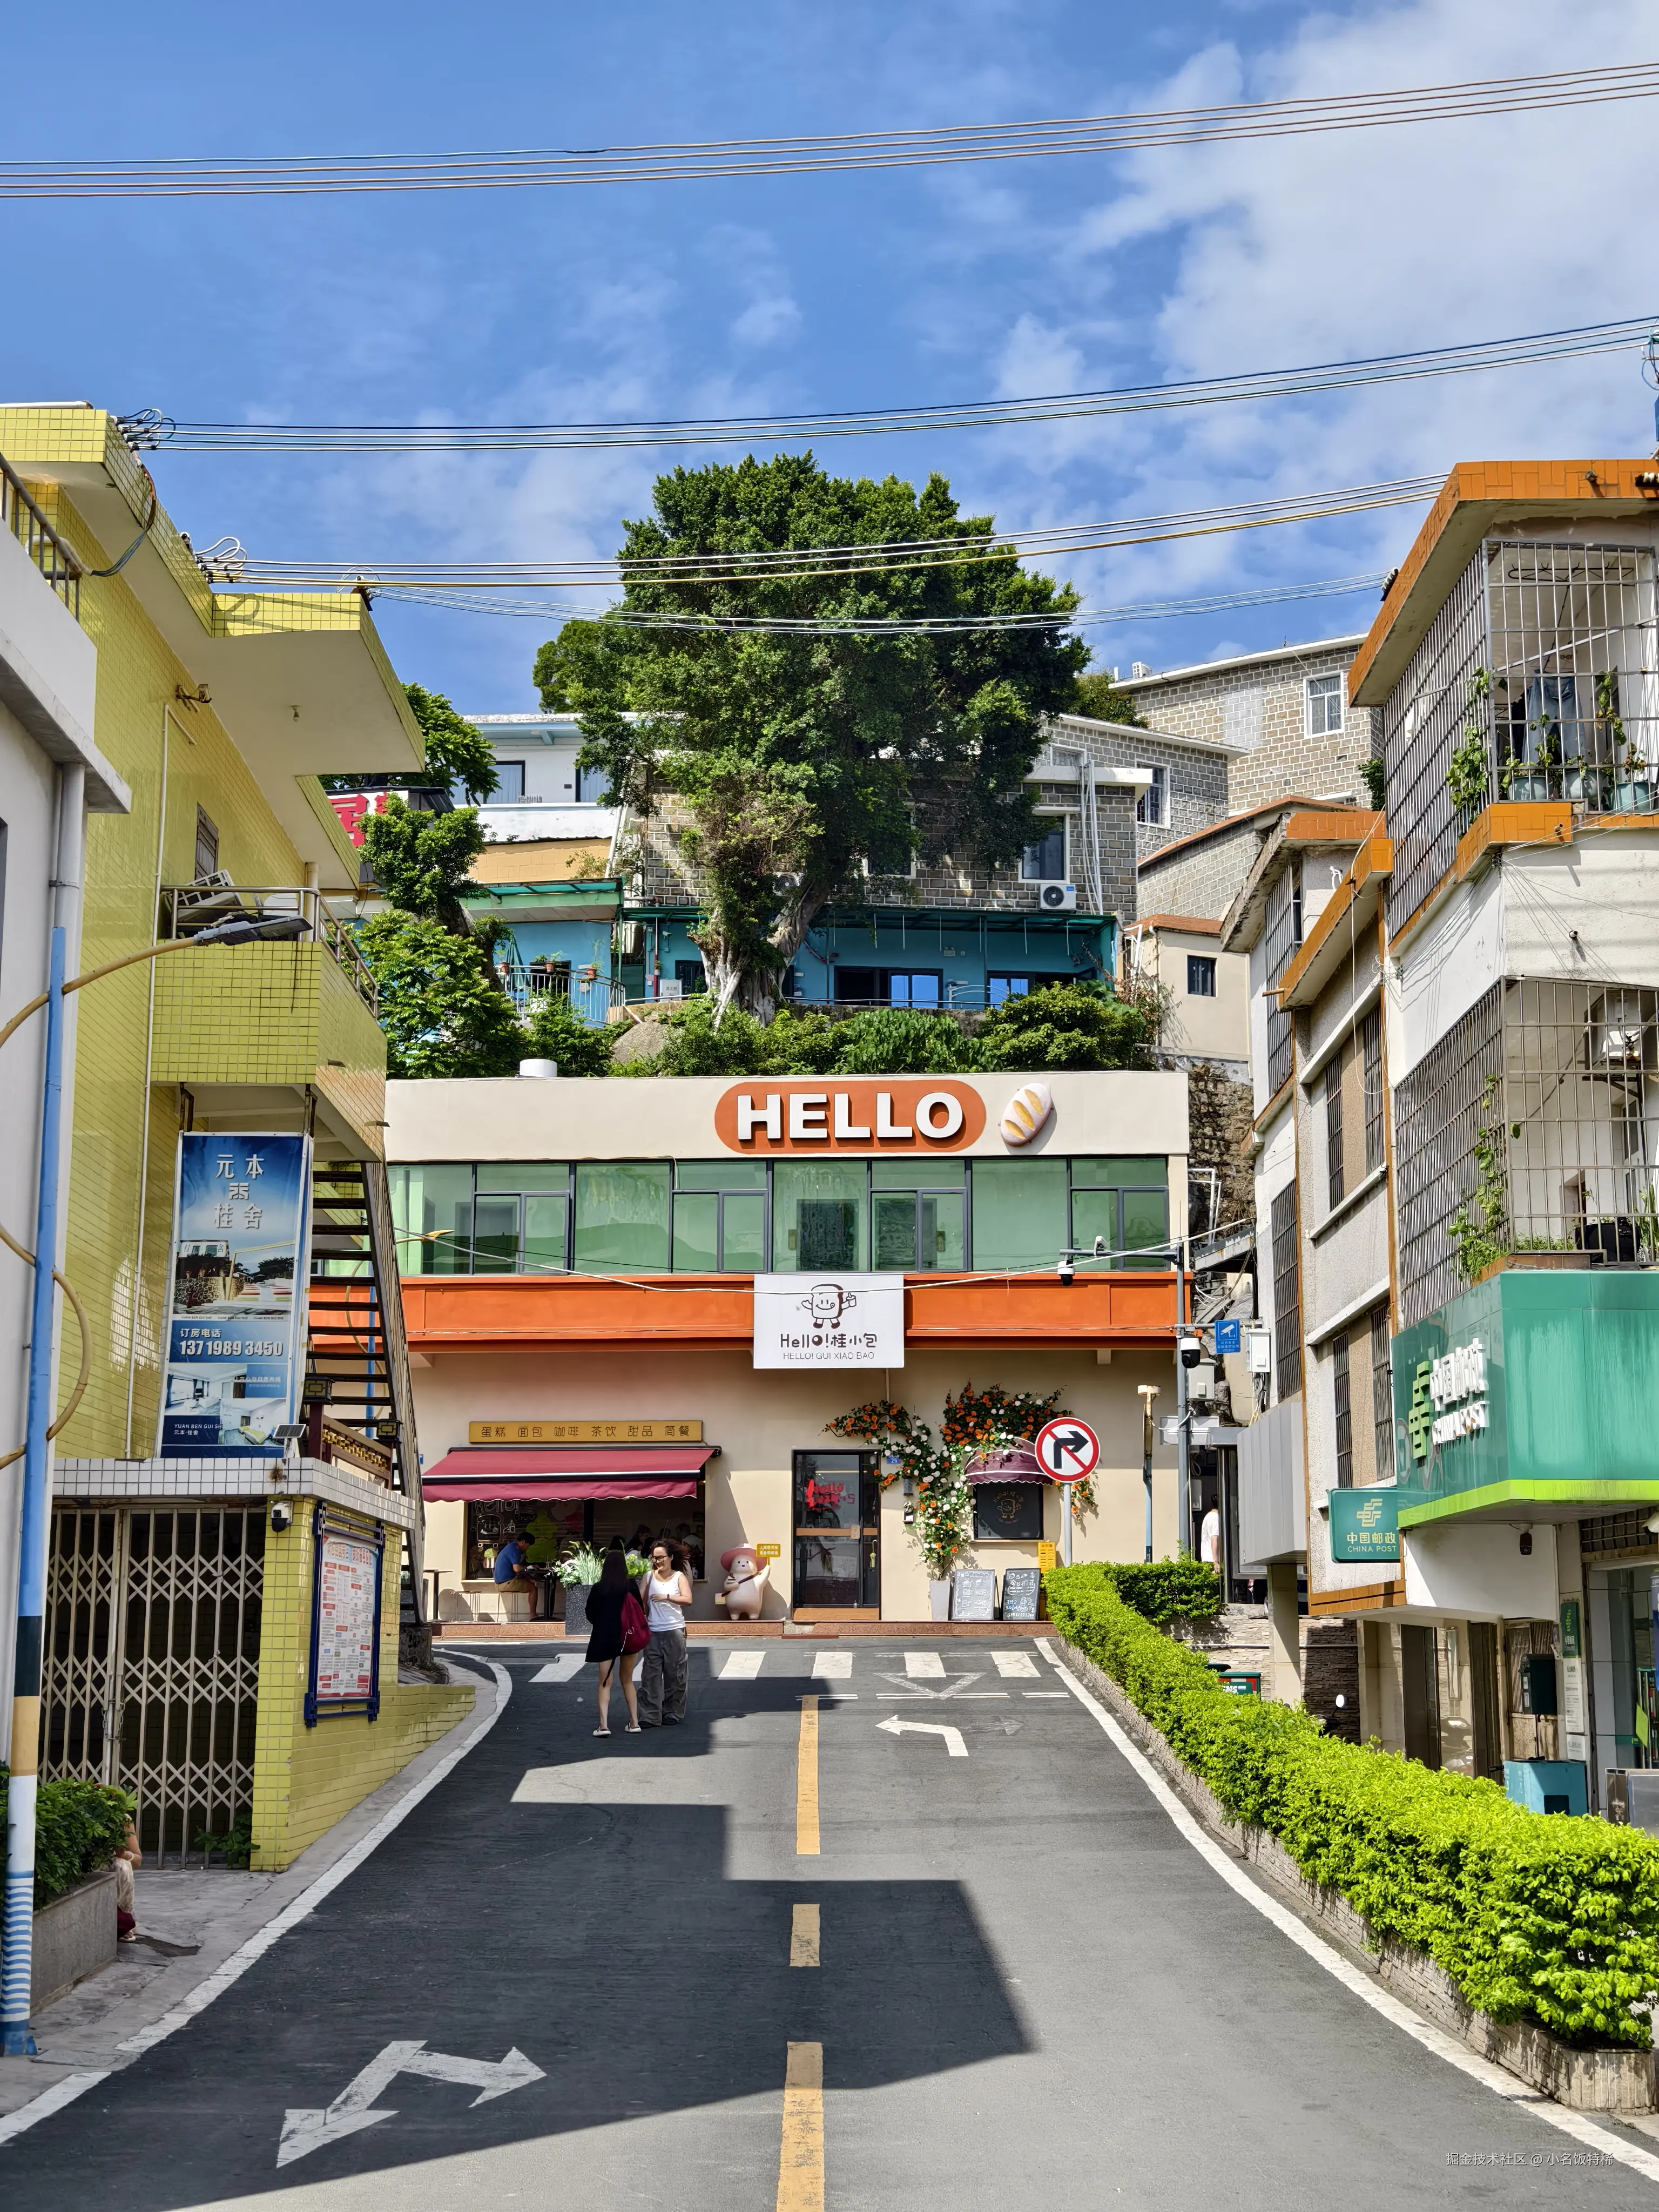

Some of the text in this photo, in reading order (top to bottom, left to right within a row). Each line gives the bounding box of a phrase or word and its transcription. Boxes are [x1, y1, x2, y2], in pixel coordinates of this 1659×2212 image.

[737, 1091, 963, 1140] HELLO
[180, 1328, 221, 1338] 订房电话
[180, 1340, 284, 1356] 137 1989 3450
[1430, 1338, 1489, 1411] 中国邮政
[481, 1425, 690, 1438] 蛋糕 面包 咖啡 茶饮 甜品 简餐
[1346, 1532, 1397, 1545] 中国邮政
